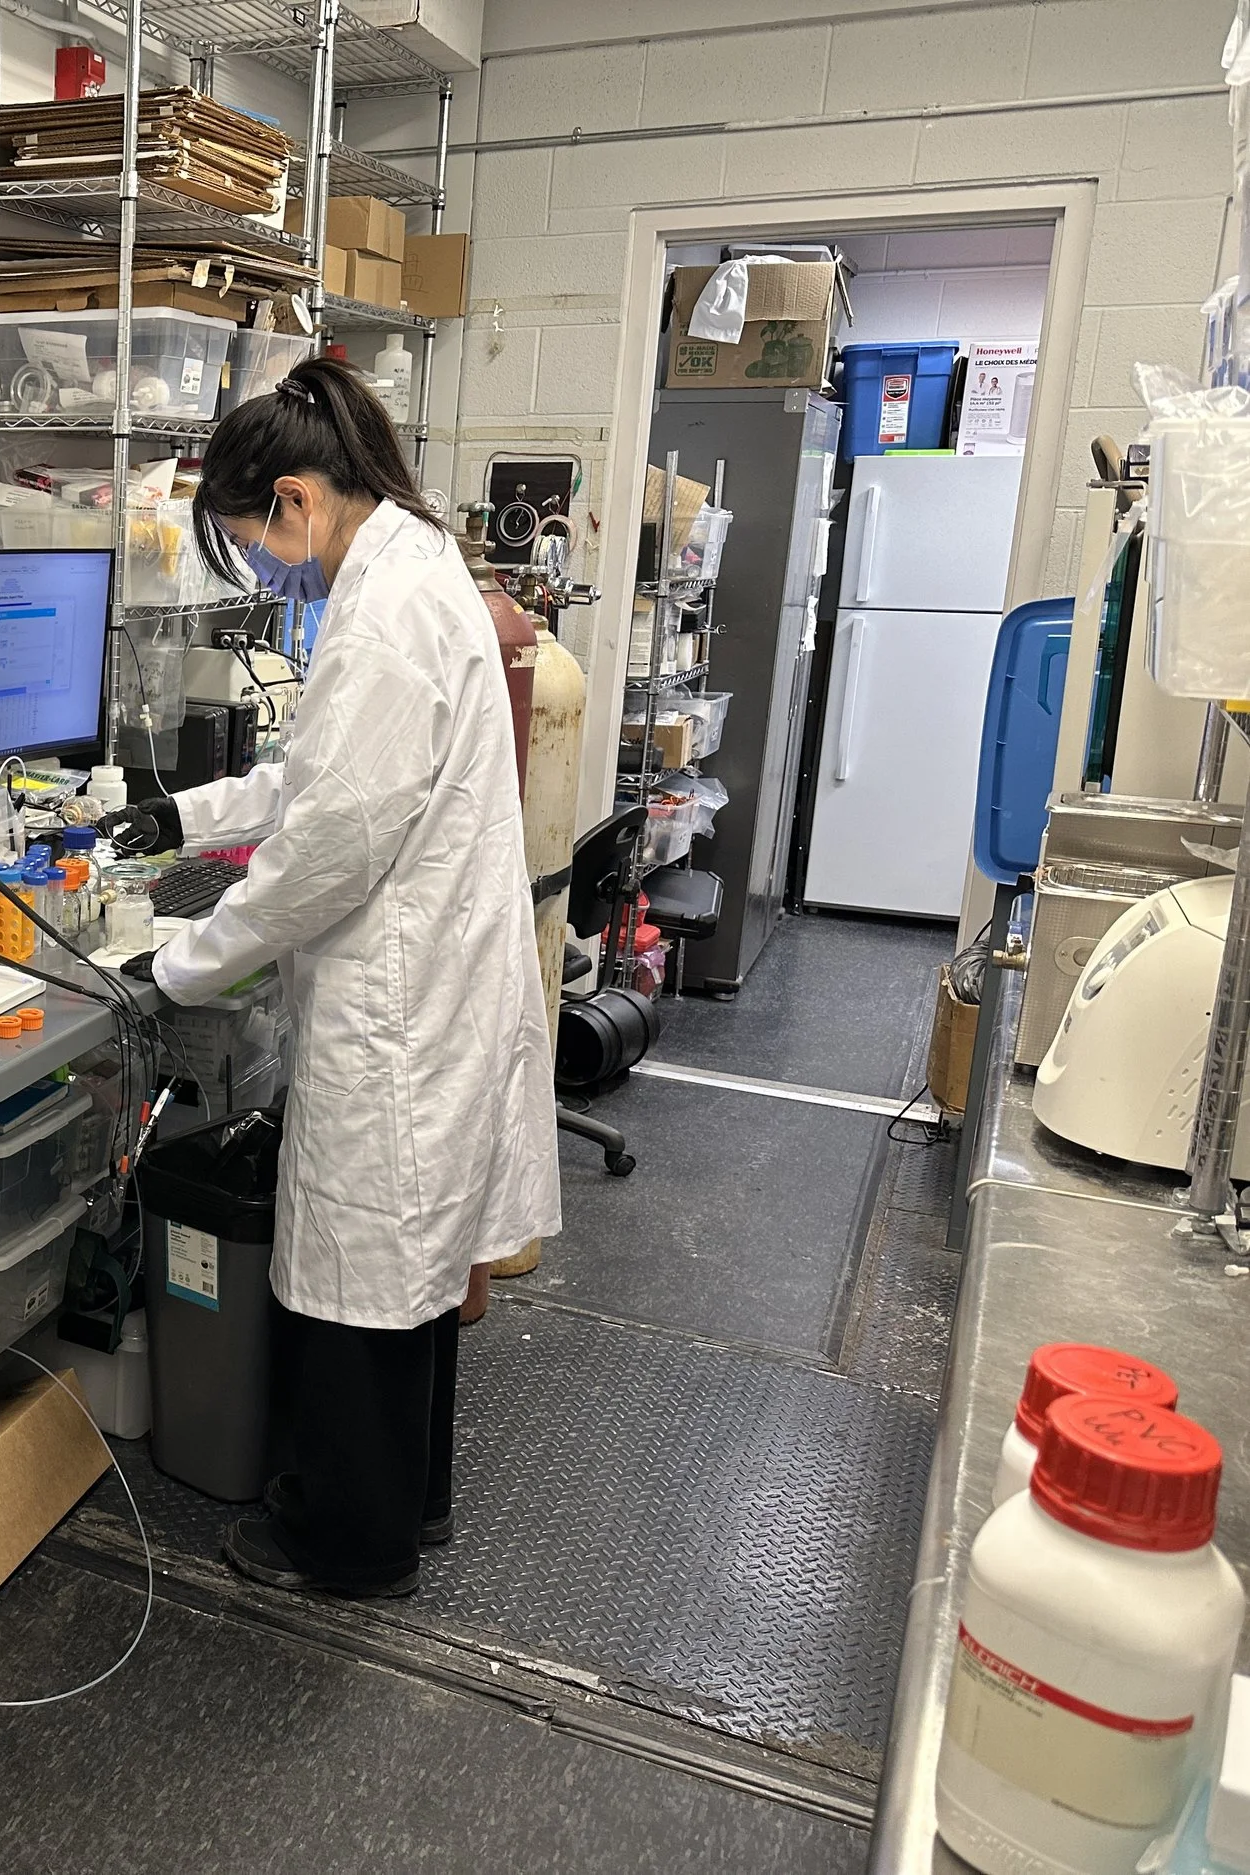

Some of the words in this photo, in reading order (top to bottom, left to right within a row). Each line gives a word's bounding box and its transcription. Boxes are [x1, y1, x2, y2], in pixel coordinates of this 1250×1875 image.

[976, 347, 1022, 356] Honeywell
[690, 357, 713, 367] OK
[1108, 1409, 1197, 1455] PVC
